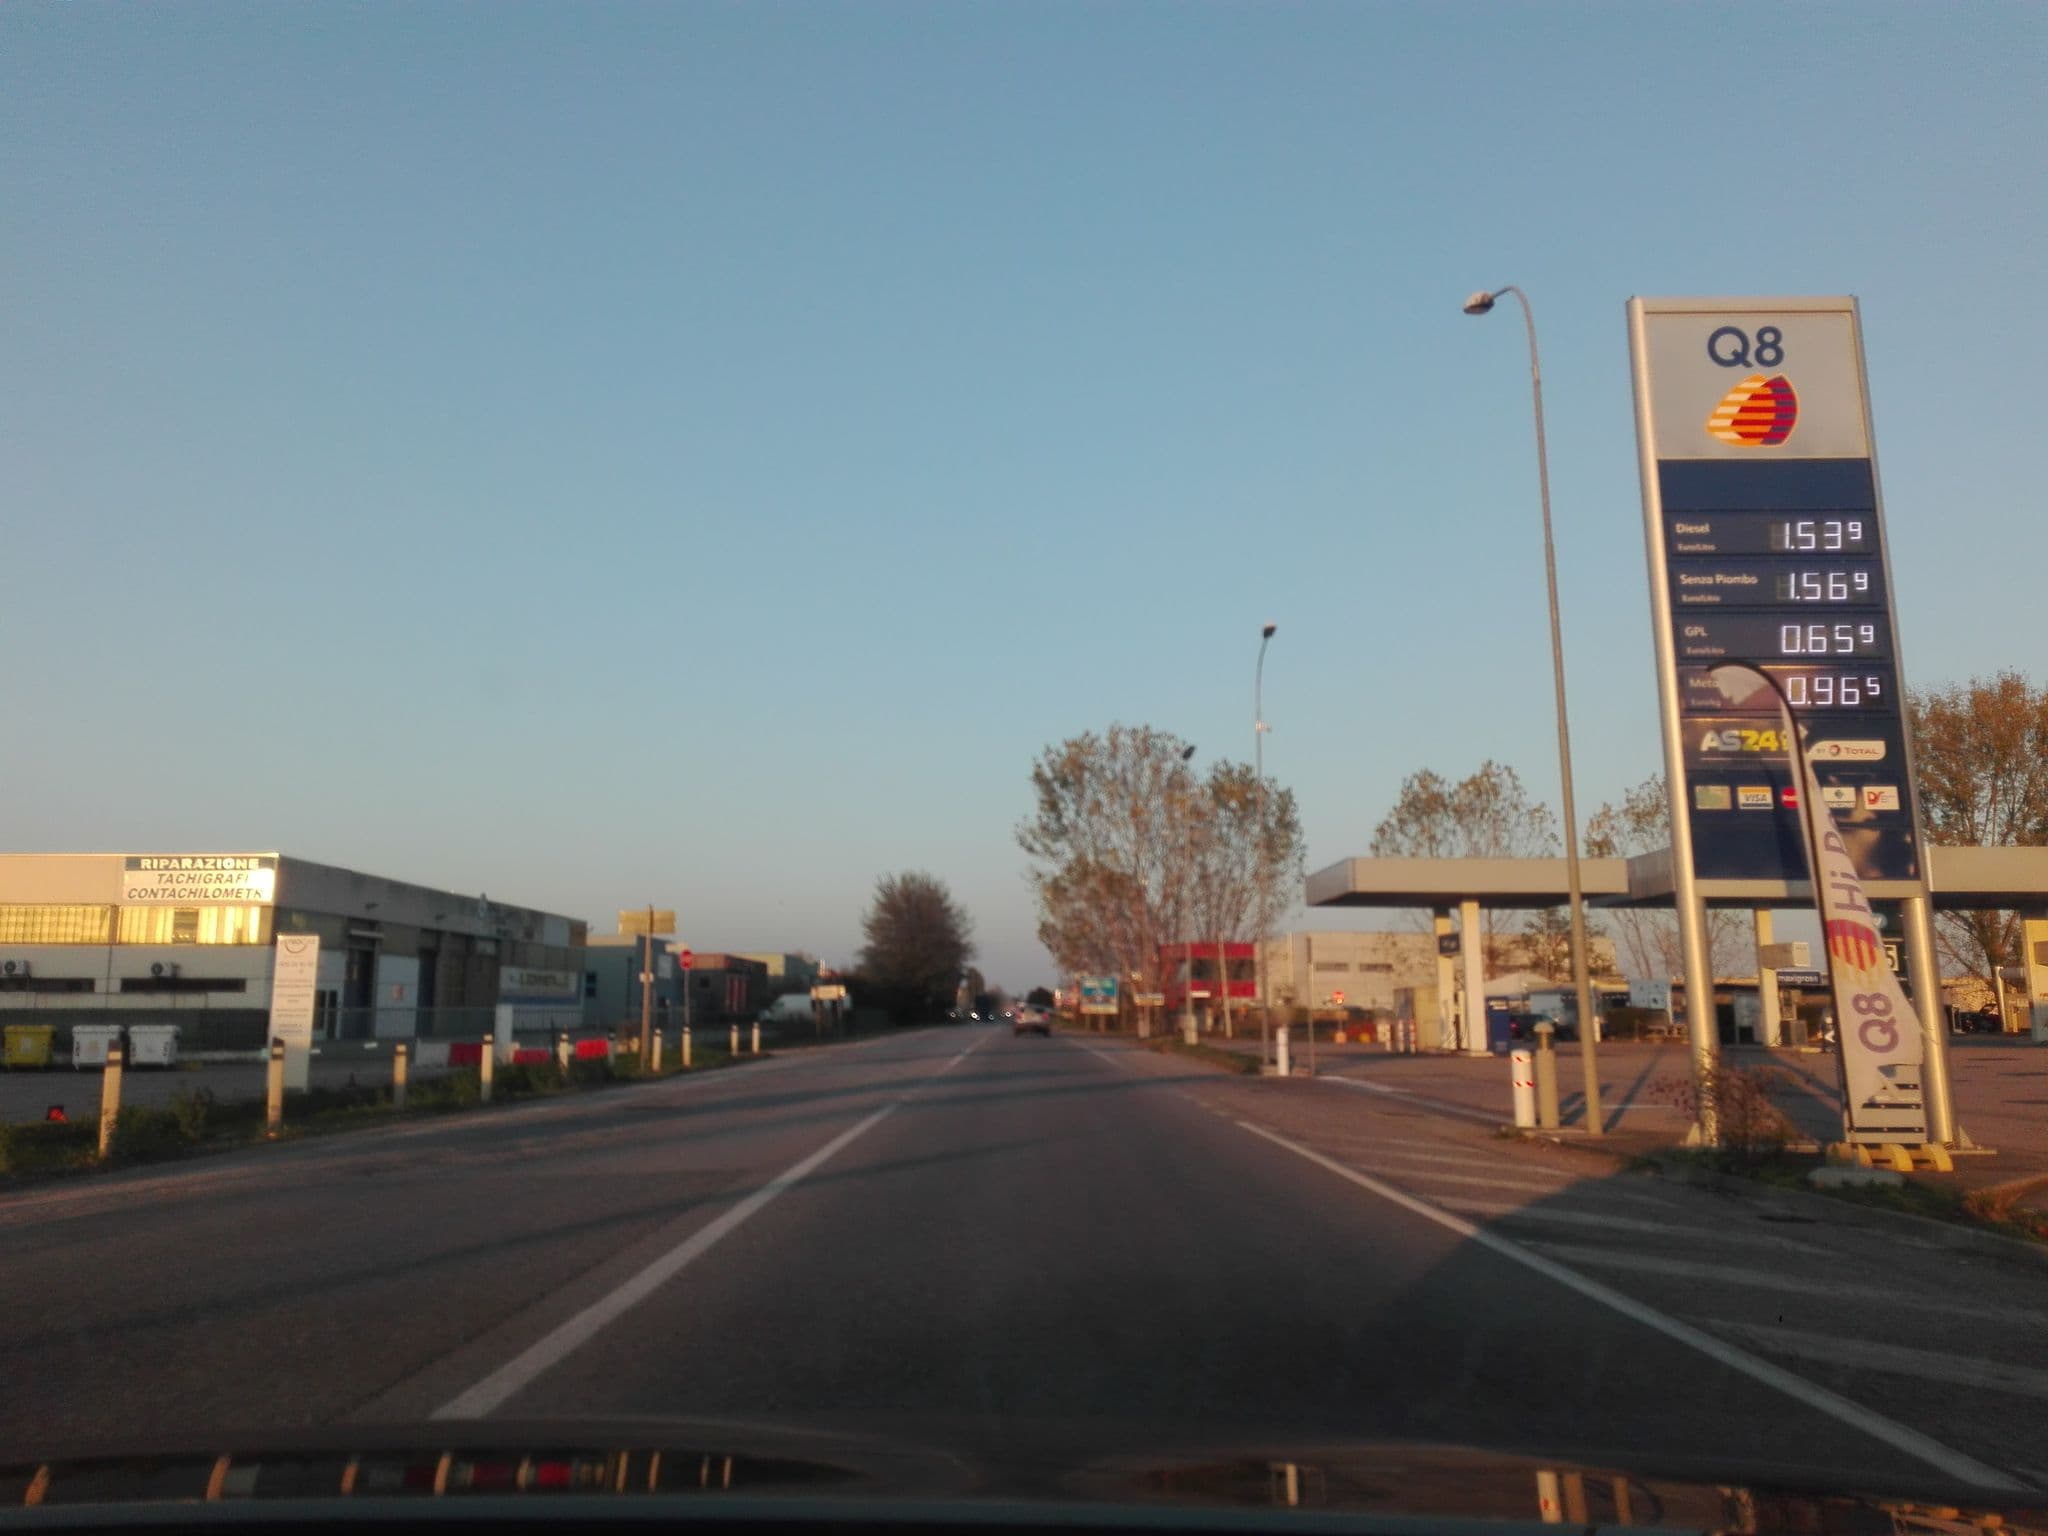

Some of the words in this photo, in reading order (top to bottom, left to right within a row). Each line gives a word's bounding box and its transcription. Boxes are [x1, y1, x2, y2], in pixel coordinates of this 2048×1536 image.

[1707, 325, 1784, 368] Q8
[1675, 523, 1710, 534] Diesel
[1680, 574, 1713, 585] Senza
[1715, 573, 1759, 585] Piombo
[1684, 626, 1708, 637] GPL
[1690, 678, 1719, 688] Meta
[1699, 730, 1777, 752] AS24
[1844, 747, 1880, 755] TOTAL
[1744, 793, 1768, 802] VISA
[157, 873, 249, 885] TACHIGRAFI
[1852, 993, 1899, 1053] Q8
